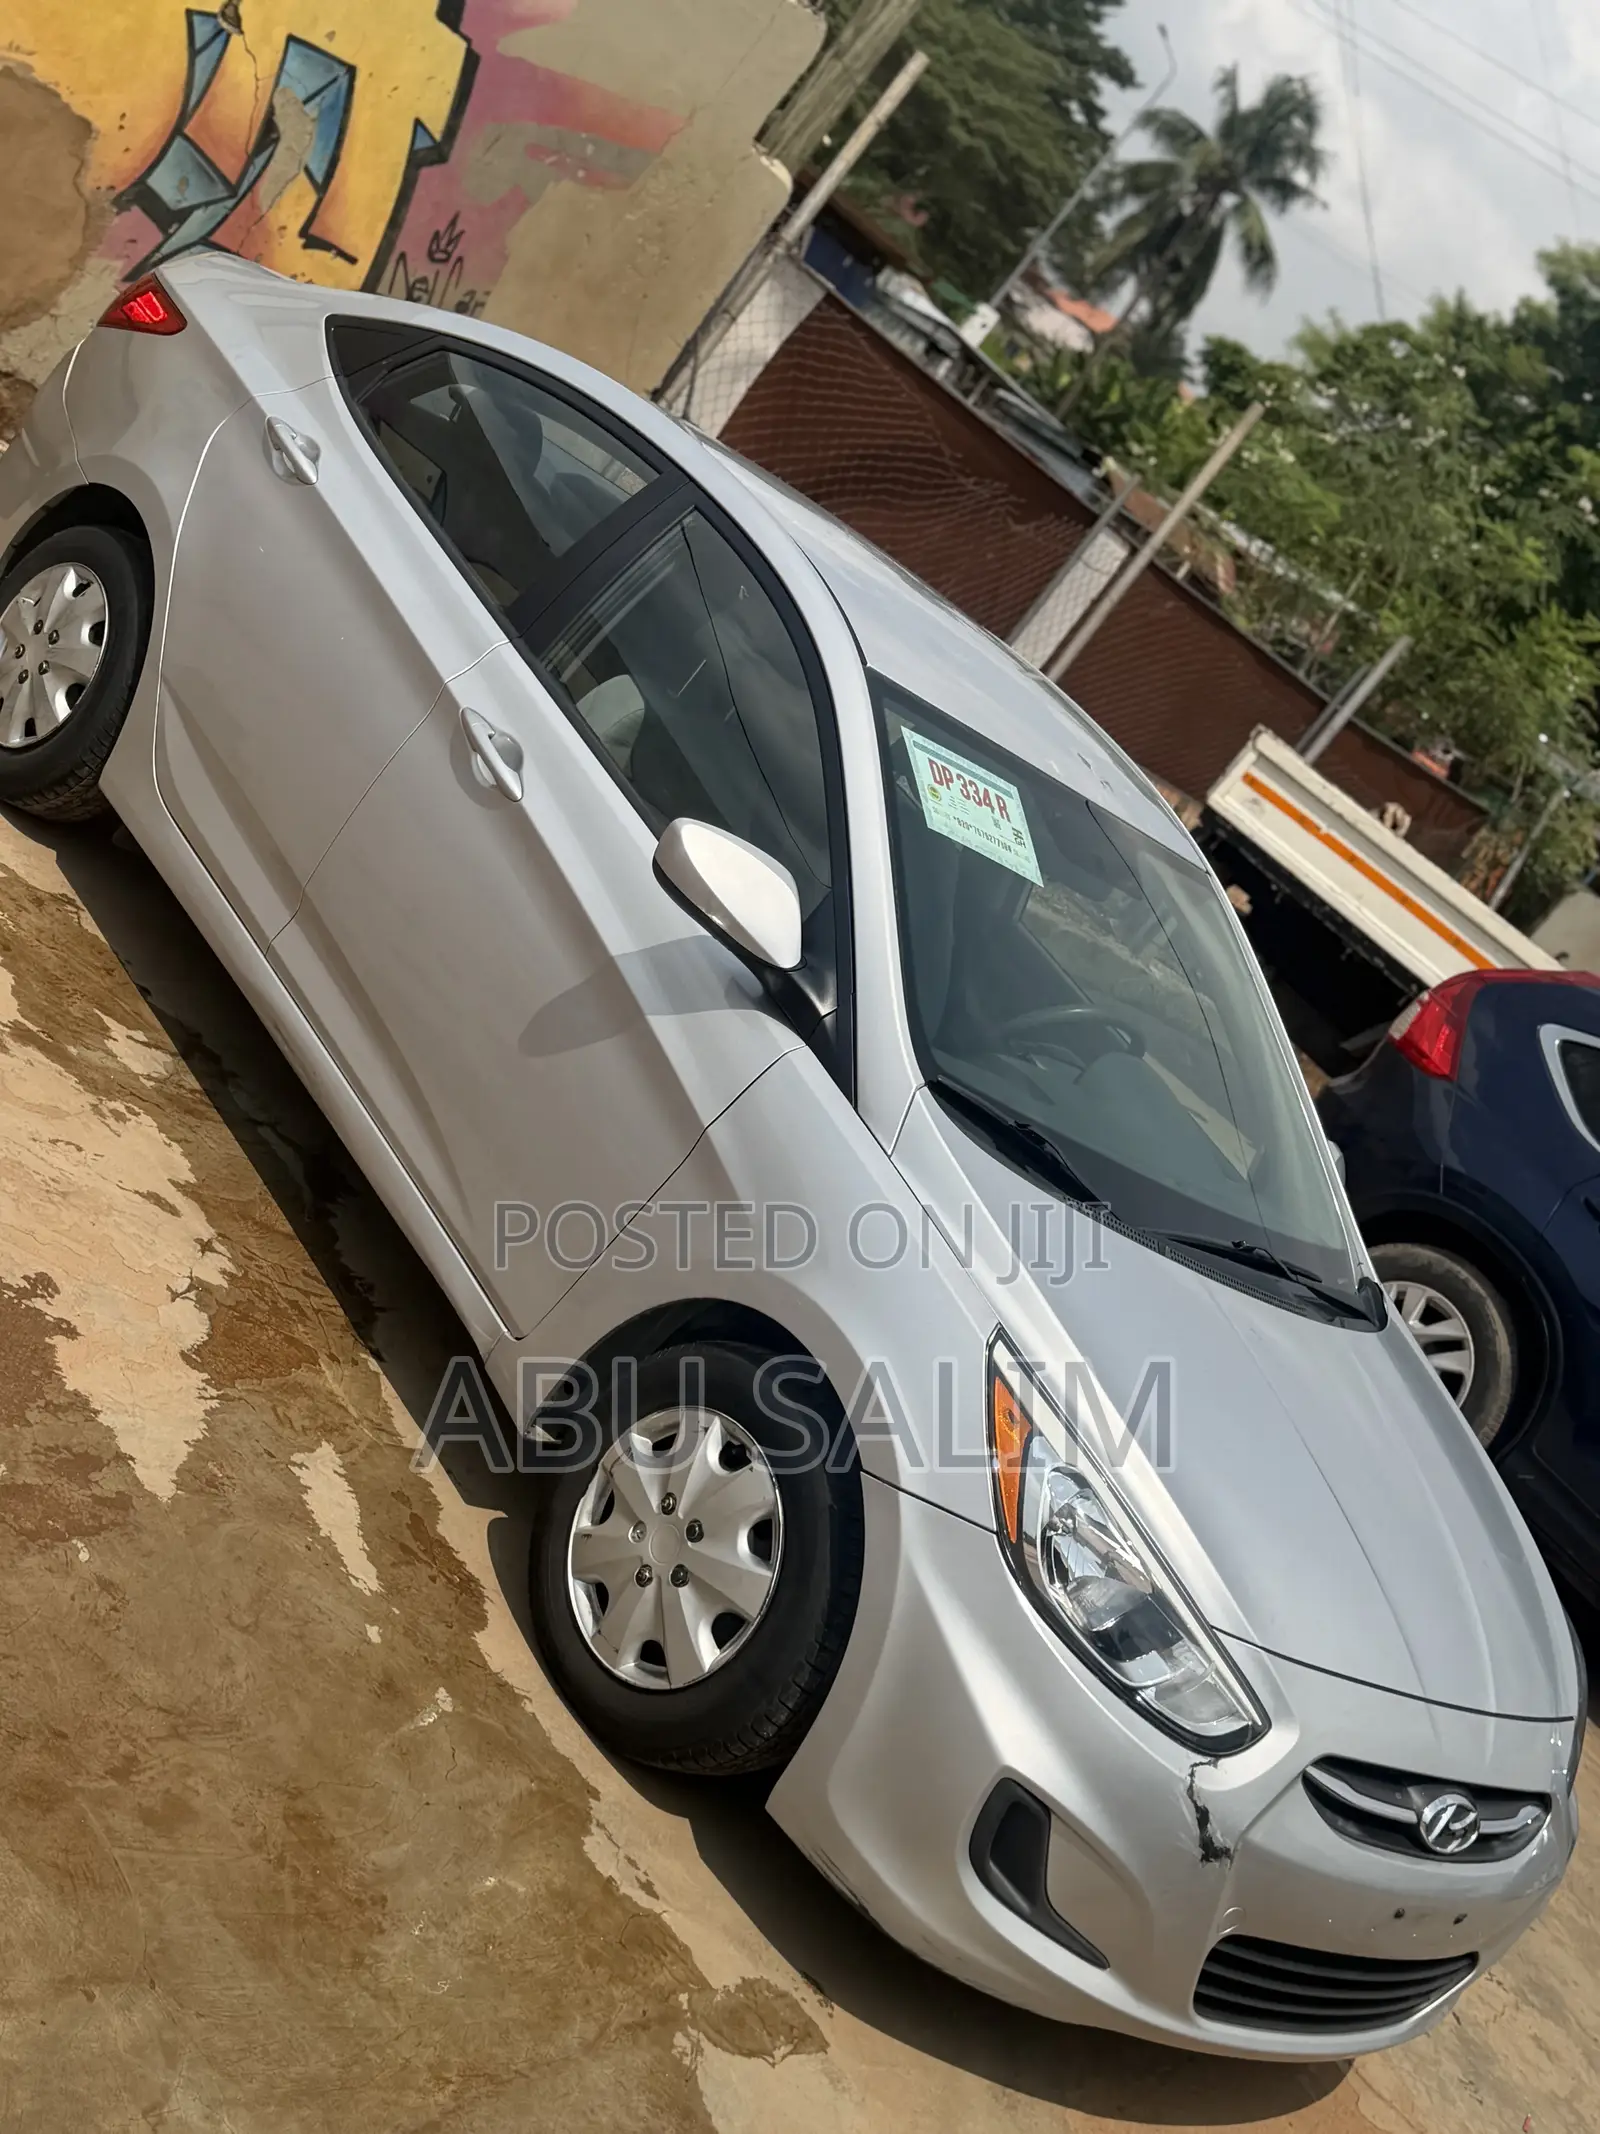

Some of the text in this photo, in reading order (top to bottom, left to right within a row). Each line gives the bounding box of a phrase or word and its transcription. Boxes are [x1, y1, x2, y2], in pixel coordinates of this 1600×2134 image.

[927, 757, 954, 791] DP
[956, 773, 995, 815] 334
[994, 793, 1012, 824] R
